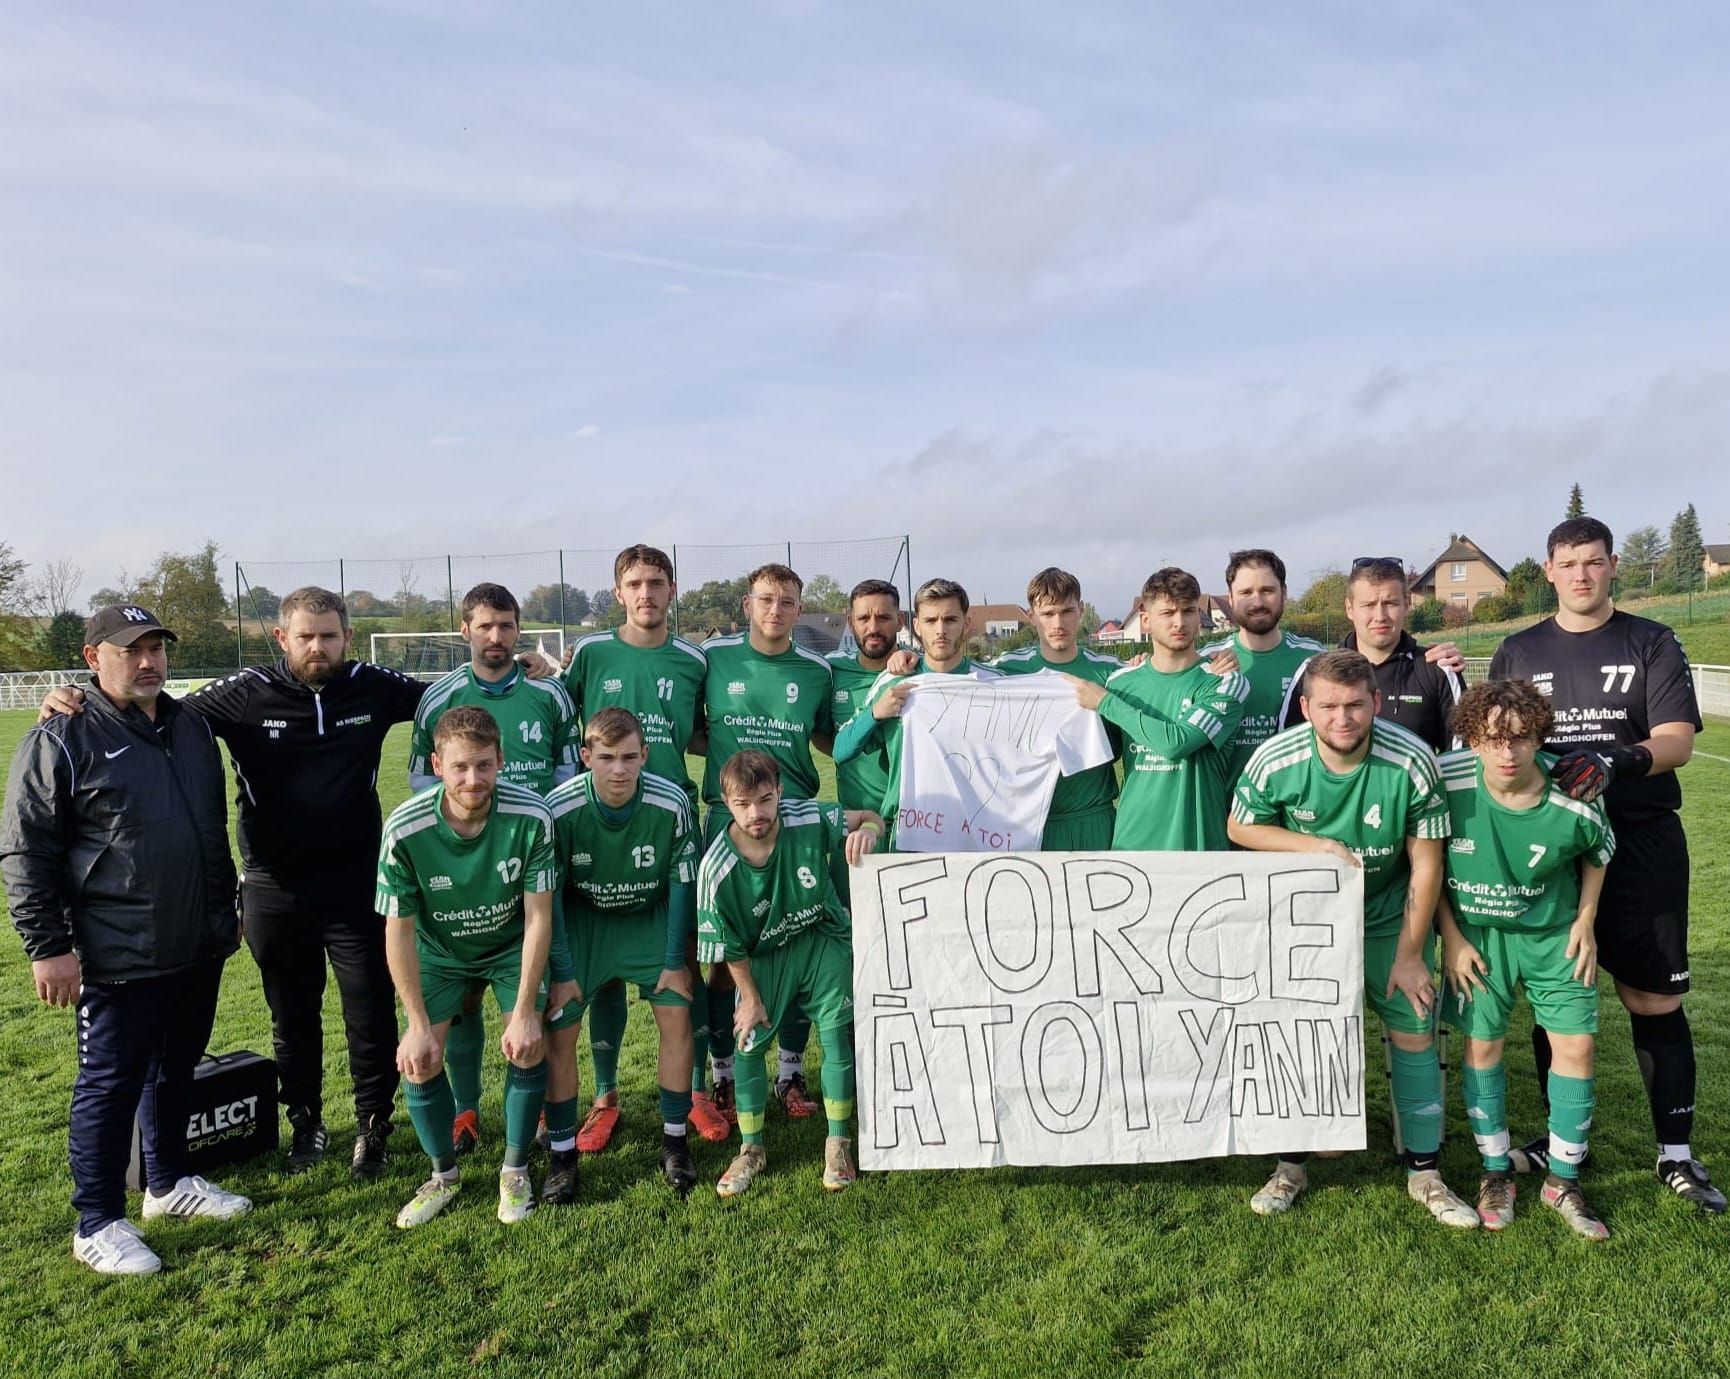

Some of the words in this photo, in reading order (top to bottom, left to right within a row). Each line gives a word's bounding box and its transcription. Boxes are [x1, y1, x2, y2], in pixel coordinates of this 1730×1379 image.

[1532, 672, 1554, 681] JAKO
[1600, 665, 1636, 694] 77
[656, 677, 674, 701] 11
[786, 682, 799, 704] 9
[262, 719, 288, 729] JAKO
[723, 714, 757, 726] Crédit
[767, 718, 804, 732] Mutuel
[929, 687, 1056, 753] YANN
[1582, 707, 1628, 721] Mutuel
[518, 720, 543, 743] 14
[1582, 723, 1602, 731] Plus
[510, 759, 546, 772] Mutuel
[898, 809, 944, 834] FORCE
[1363, 804, 1382, 829] 4
[631, 844, 656, 869] 13
[1527, 844, 1547, 868] 7
[496, 857, 522, 884] 12
[796, 866, 817, 889] 8
[616, 893, 635, 901] Plus
[617, 880, 659, 893] Mutuel
[1447, 878, 1490, 896] Crédit
[433, 909, 475, 922] Crédit
[491, 895, 521, 915] Mut
[796, 901, 823, 921] Mut
[1474, 897, 1503, 907] Régio
[877, 857, 1339, 1005] FORCE
[931, 1001, 1150, 1146] TOI
[1178, 1007, 1361, 1123] YANN
[186, 1095, 258, 1140] ELECT
[188, 1126, 244, 1152] OFCARE
